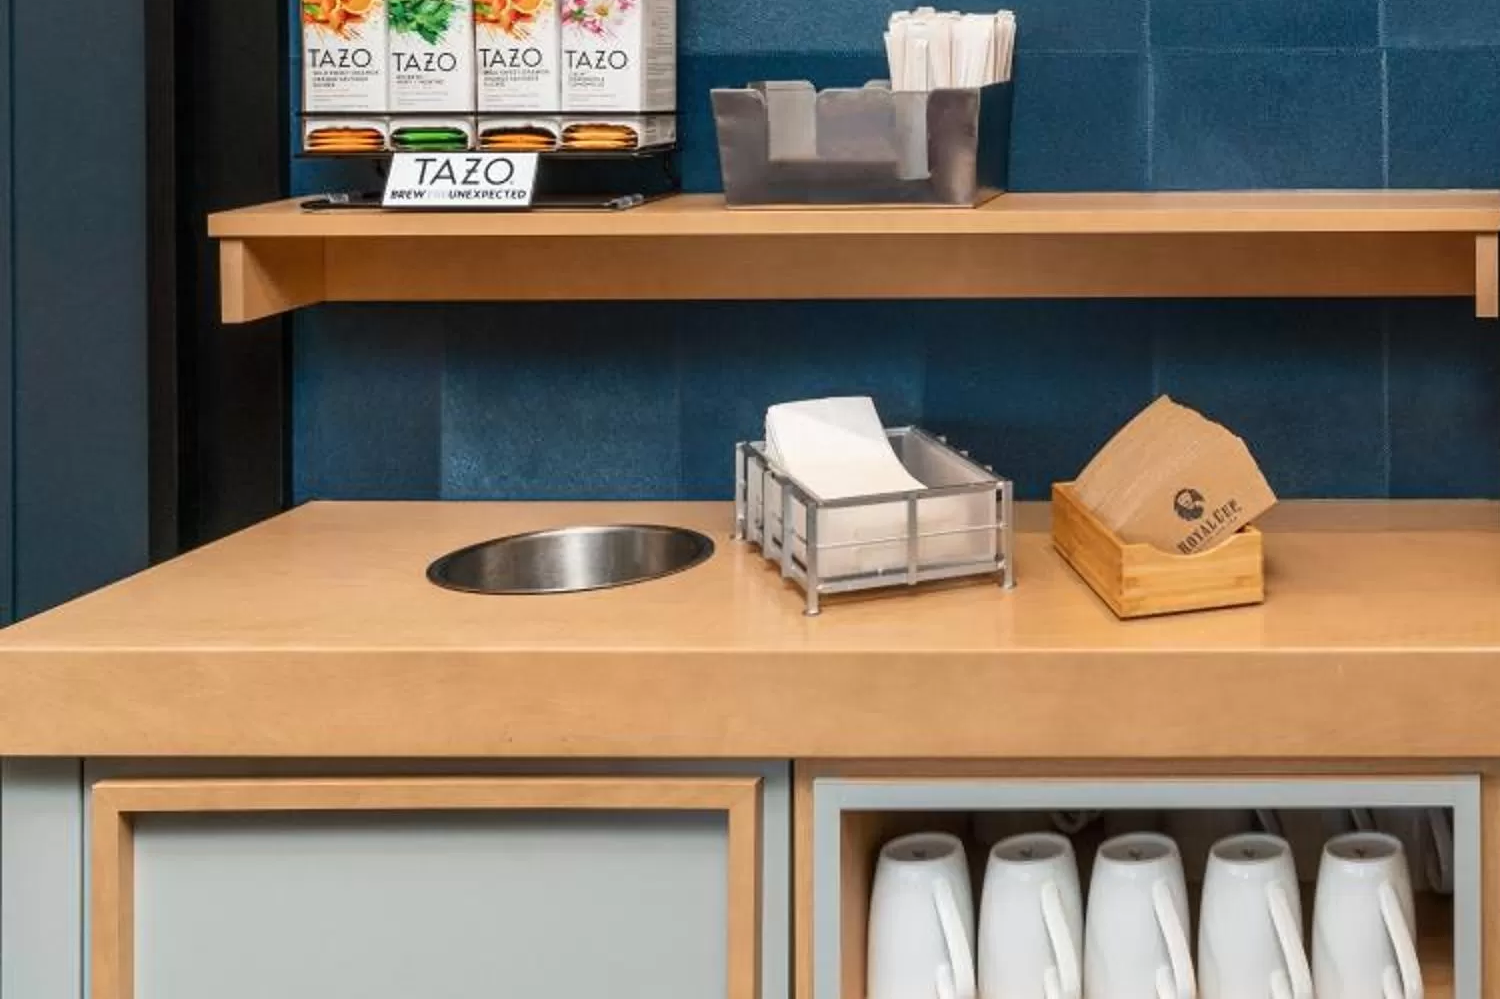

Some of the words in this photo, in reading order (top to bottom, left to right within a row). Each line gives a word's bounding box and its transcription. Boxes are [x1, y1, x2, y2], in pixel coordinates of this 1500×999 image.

[308, 48, 372, 68] TAZO
[392, 52, 457, 72] TAZO
[479, 48, 542, 68] TAZO
[564, 50, 628, 69] TAZO
[414, 158, 515, 185] TAZO
[390, 189, 427, 199] BREW
[449, 189, 527, 200] UNEXPECTED
